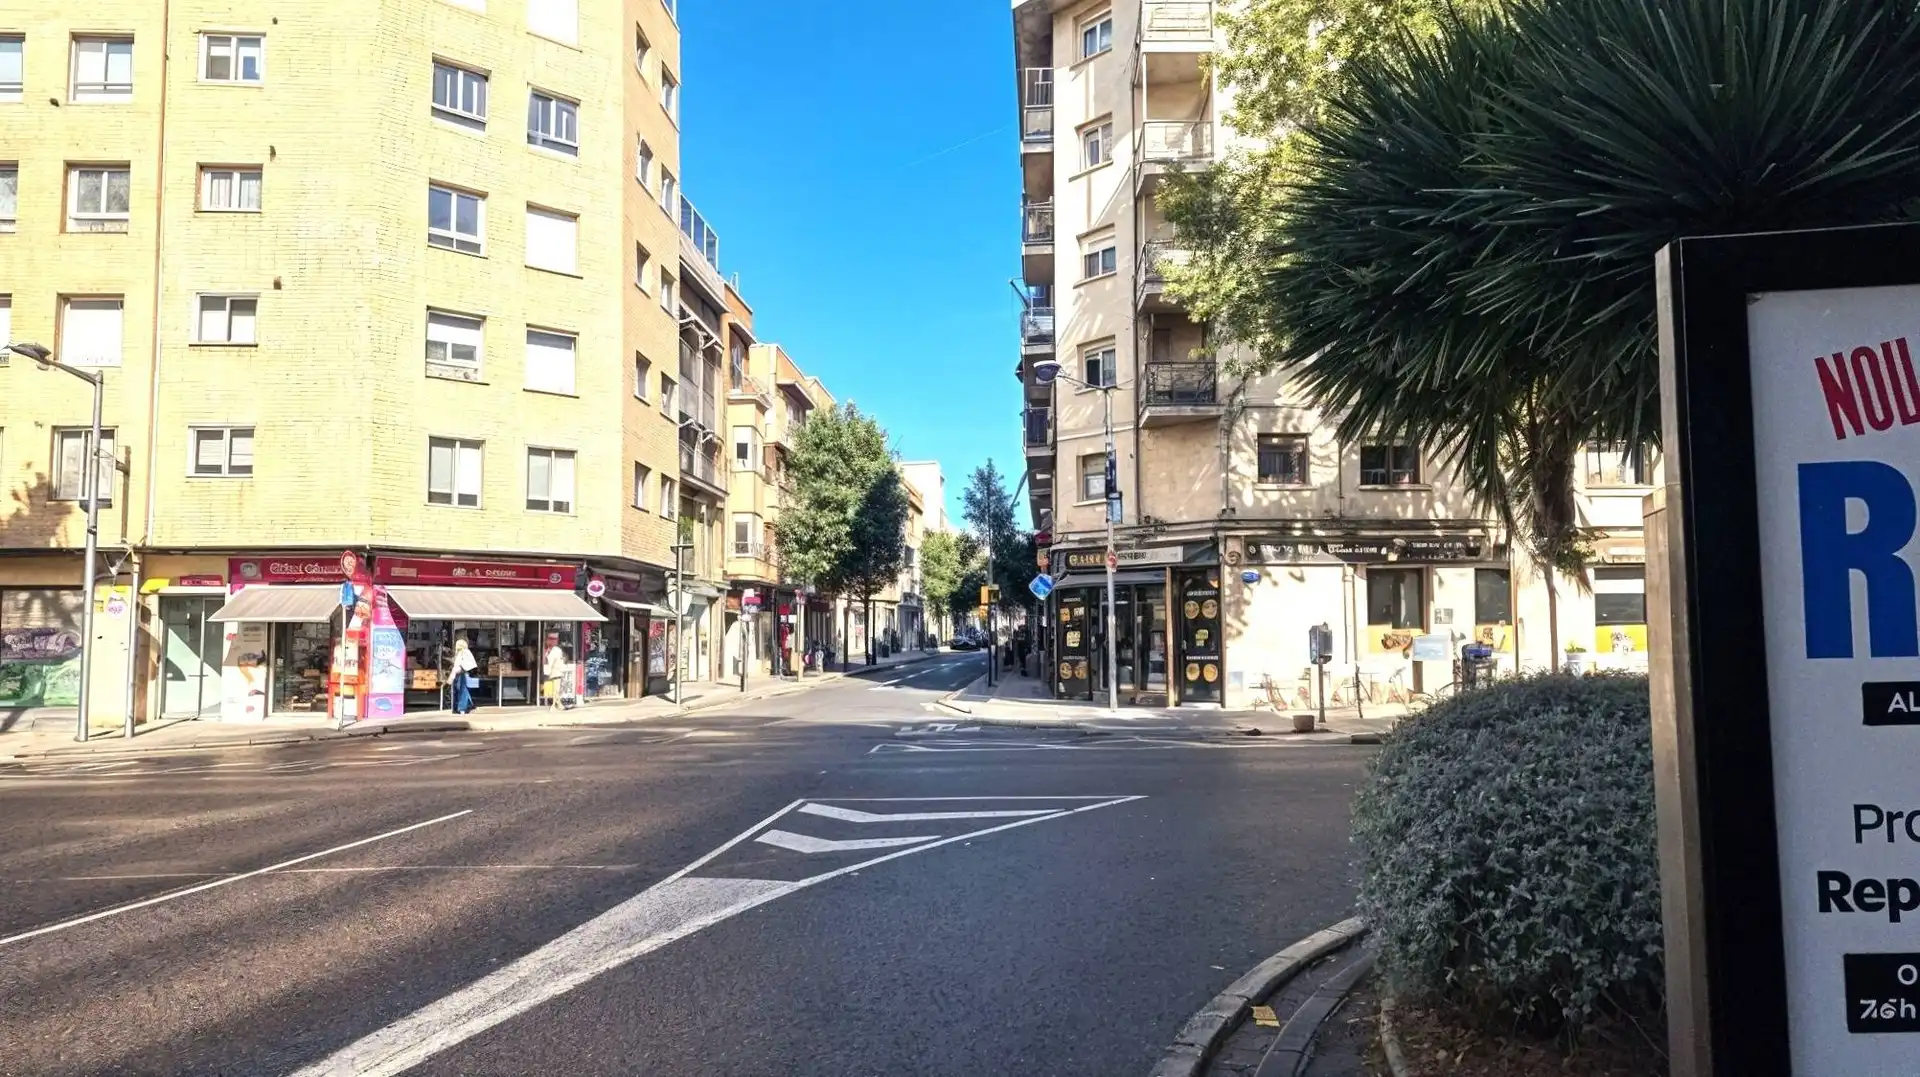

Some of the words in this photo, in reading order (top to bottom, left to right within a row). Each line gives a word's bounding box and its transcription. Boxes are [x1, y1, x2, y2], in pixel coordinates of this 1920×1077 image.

[1798, 461, 1919, 658] R
[1888, 691, 1920, 713] AL
[1817, 870, 1920, 923] Rep
